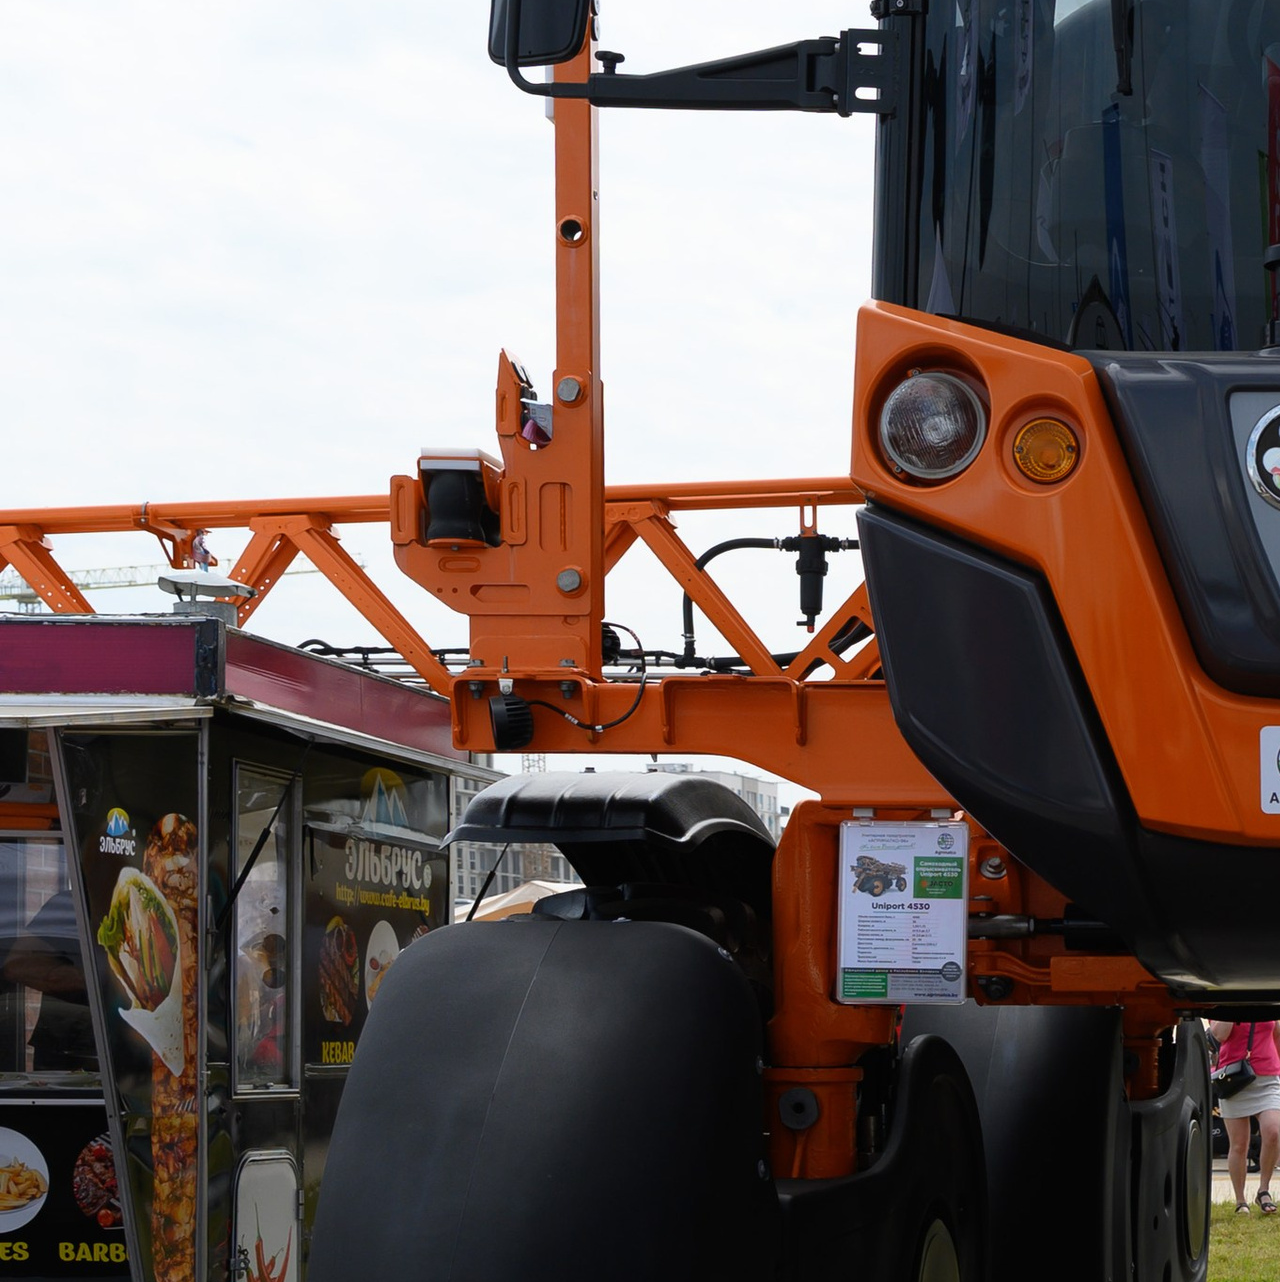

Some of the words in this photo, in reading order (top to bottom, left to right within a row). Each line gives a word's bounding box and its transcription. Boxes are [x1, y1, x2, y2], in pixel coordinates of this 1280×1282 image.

[99, 835, 136, 857] ЭЛЬБРУС
[345, 839, 423, 890] ЭЛЬБРУС
[335, 881, 431, 917] http://www.cafe-elbrus.by
[871, 902, 905, 911] Uniport
[907, 902, 931, 911] 4530
[322, 1040, 355, 1064] KEBAB
[58, 1241, 130, 1263] BARB
